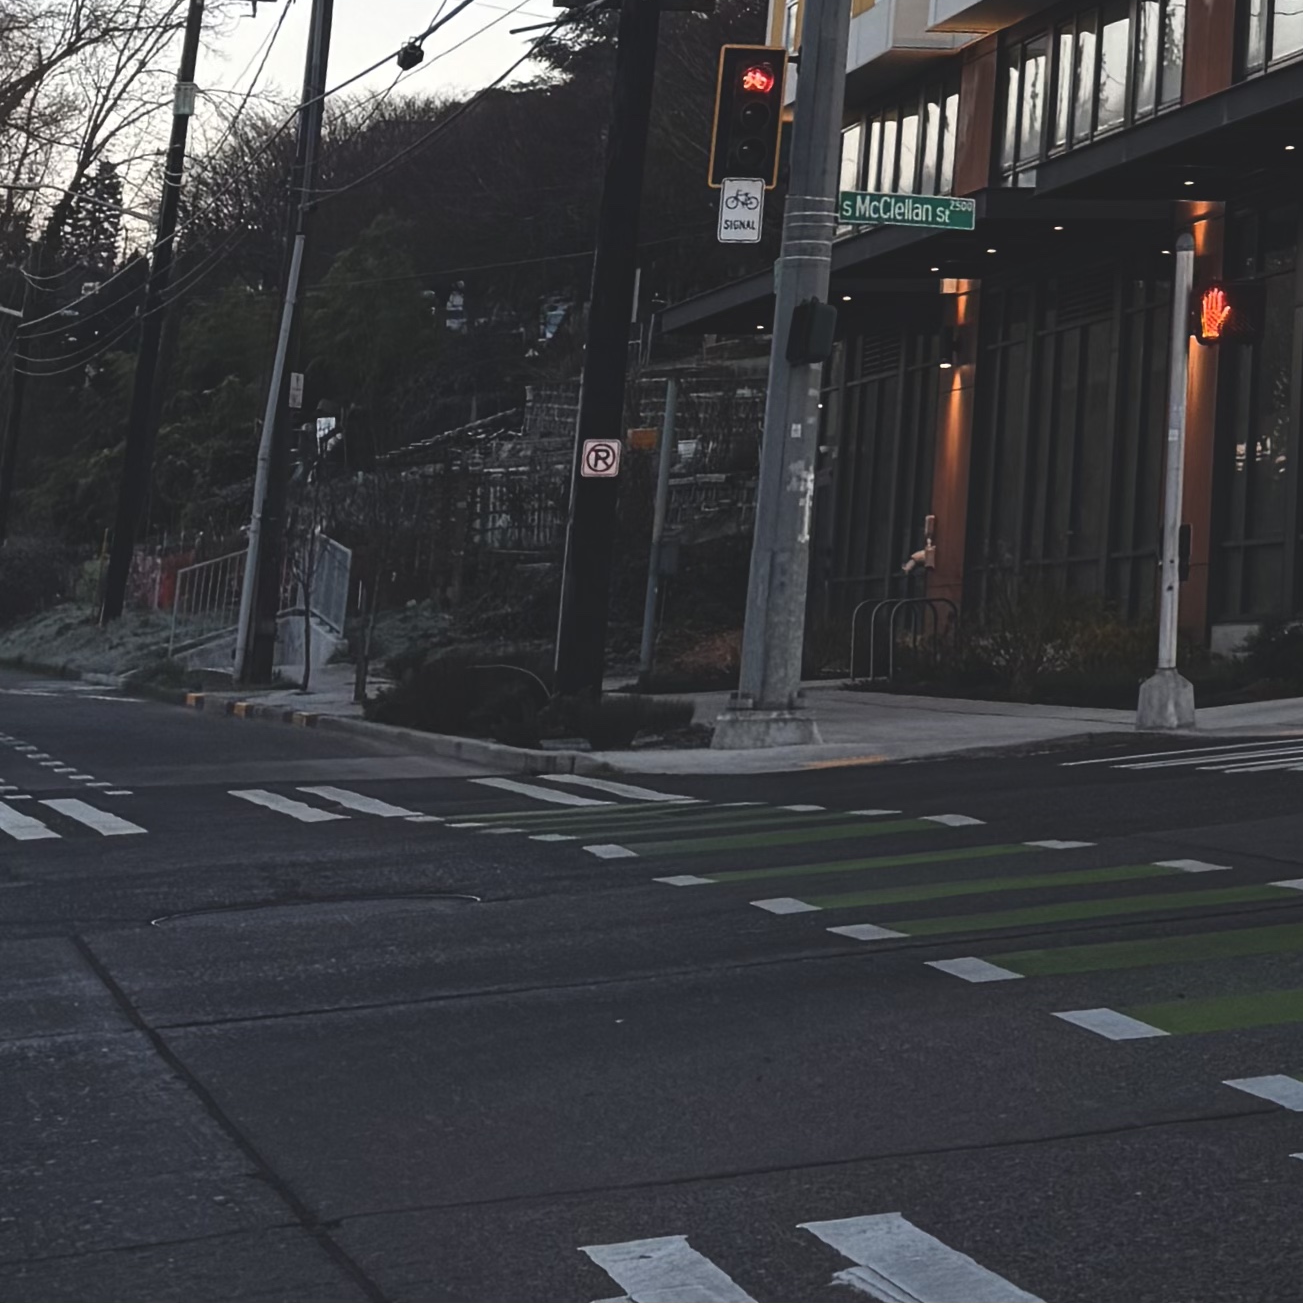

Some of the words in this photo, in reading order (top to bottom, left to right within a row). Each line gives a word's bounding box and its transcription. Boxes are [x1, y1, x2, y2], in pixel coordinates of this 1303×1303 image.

[855, 195, 932, 222] McClellan
[936, 206, 950, 223] St
[949, 200, 973, 211] 2500
[723, 219, 756, 231] SIGNAL
